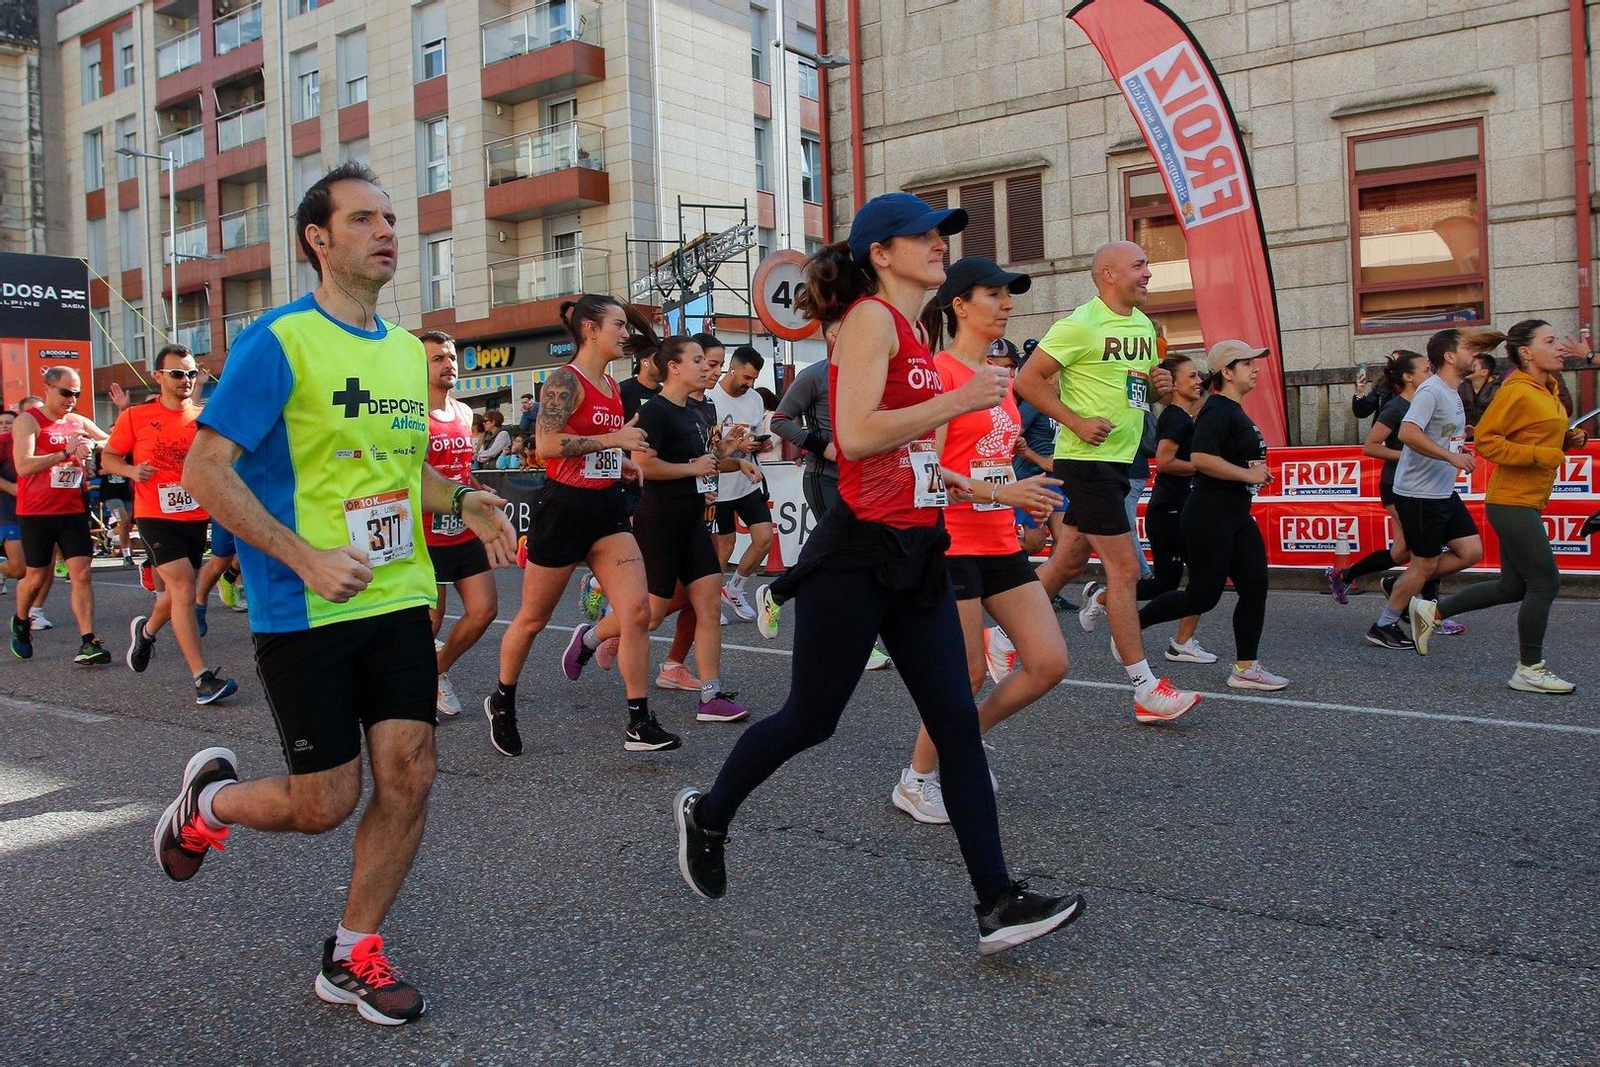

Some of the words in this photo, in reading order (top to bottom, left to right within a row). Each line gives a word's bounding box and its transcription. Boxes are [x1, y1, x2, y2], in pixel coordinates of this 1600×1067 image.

[0, 282, 58, 300] DOSA
[464, 345, 510, 370] Bippy
[1102, 337, 1152, 361] RUN
[368, 398, 425, 417] DEPORTE
[595, 451, 618, 470] 386
[1284, 462, 1357, 485] FROIZ
[168, 491, 193, 506] 348
[366, 513, 402, 551] 377
[1282, 517, 1356, 540] FROIZ
